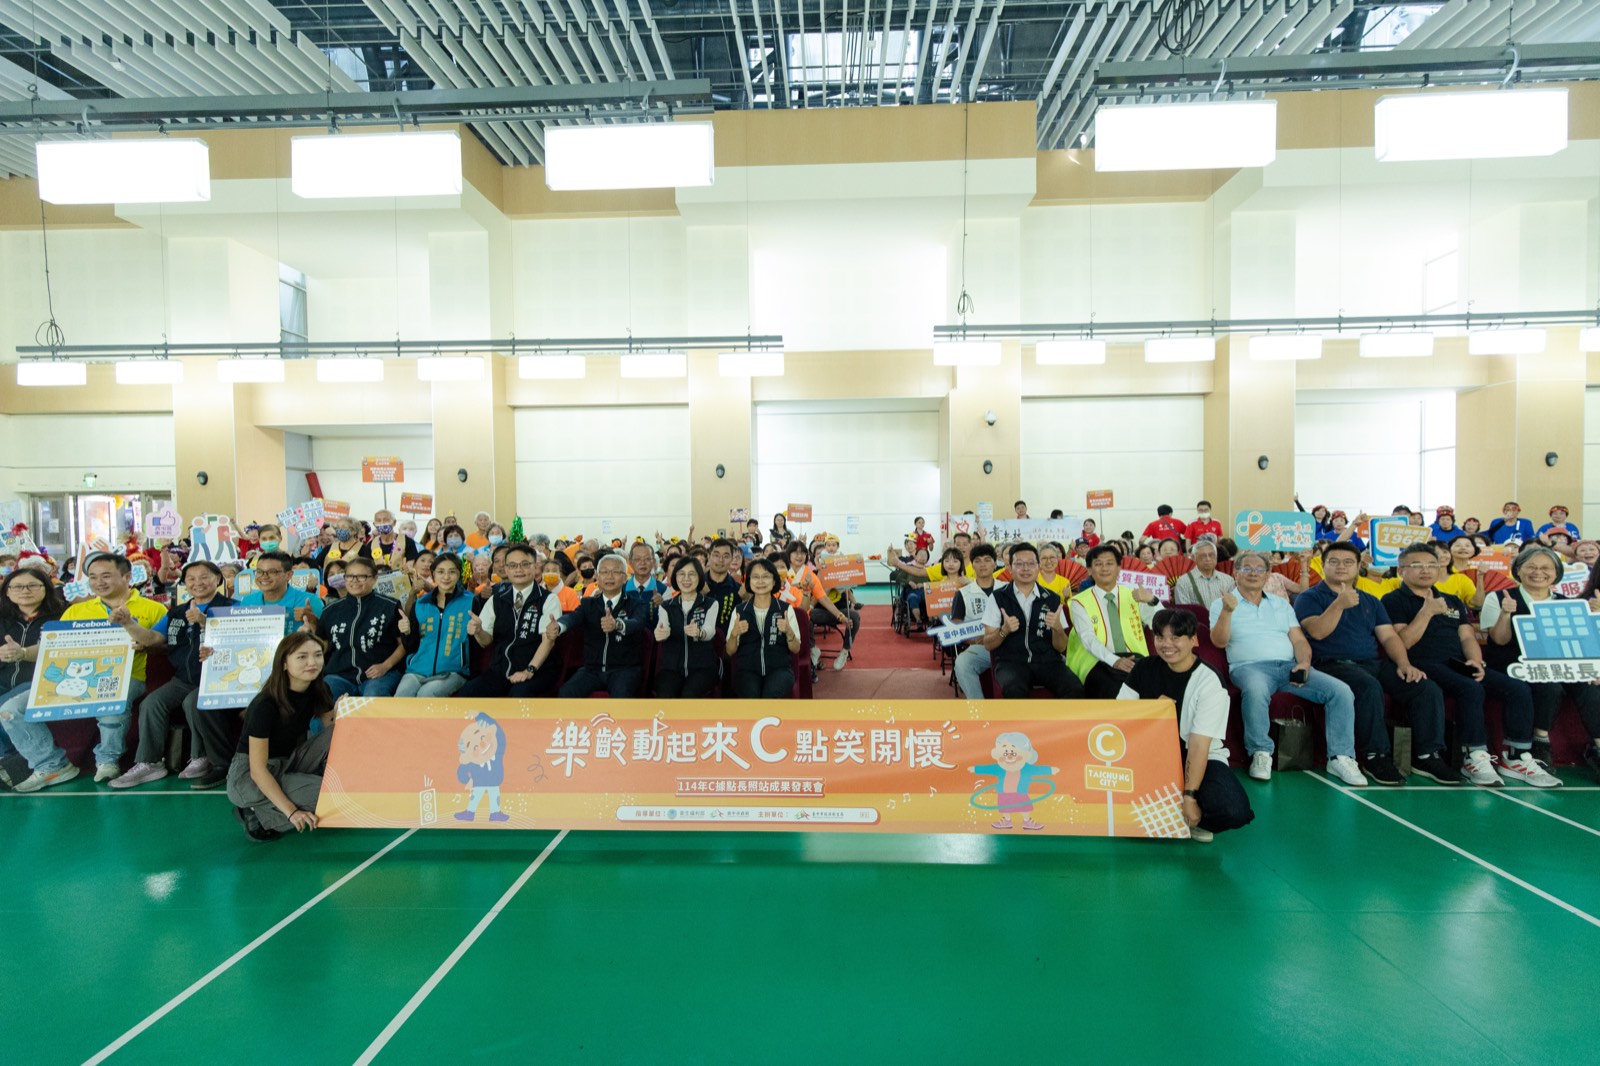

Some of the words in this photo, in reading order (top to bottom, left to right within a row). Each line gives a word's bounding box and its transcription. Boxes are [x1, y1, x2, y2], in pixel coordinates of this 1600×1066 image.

[230, 607, 263, 615] facebook
[72, 620, 111, 629] facebook
[1511, 663, 1599, 680] C據點長
[545, 716, 958, 777] 樂齡動起來C點笑開懷
[1095, 730, 1116, 757] C
[1088, 769, 1130, 782] TAICHUNG
[677, 781, 824, 793] 114年C據點長照站成果發表會
[1099, 778, 1117, 788] CITY
